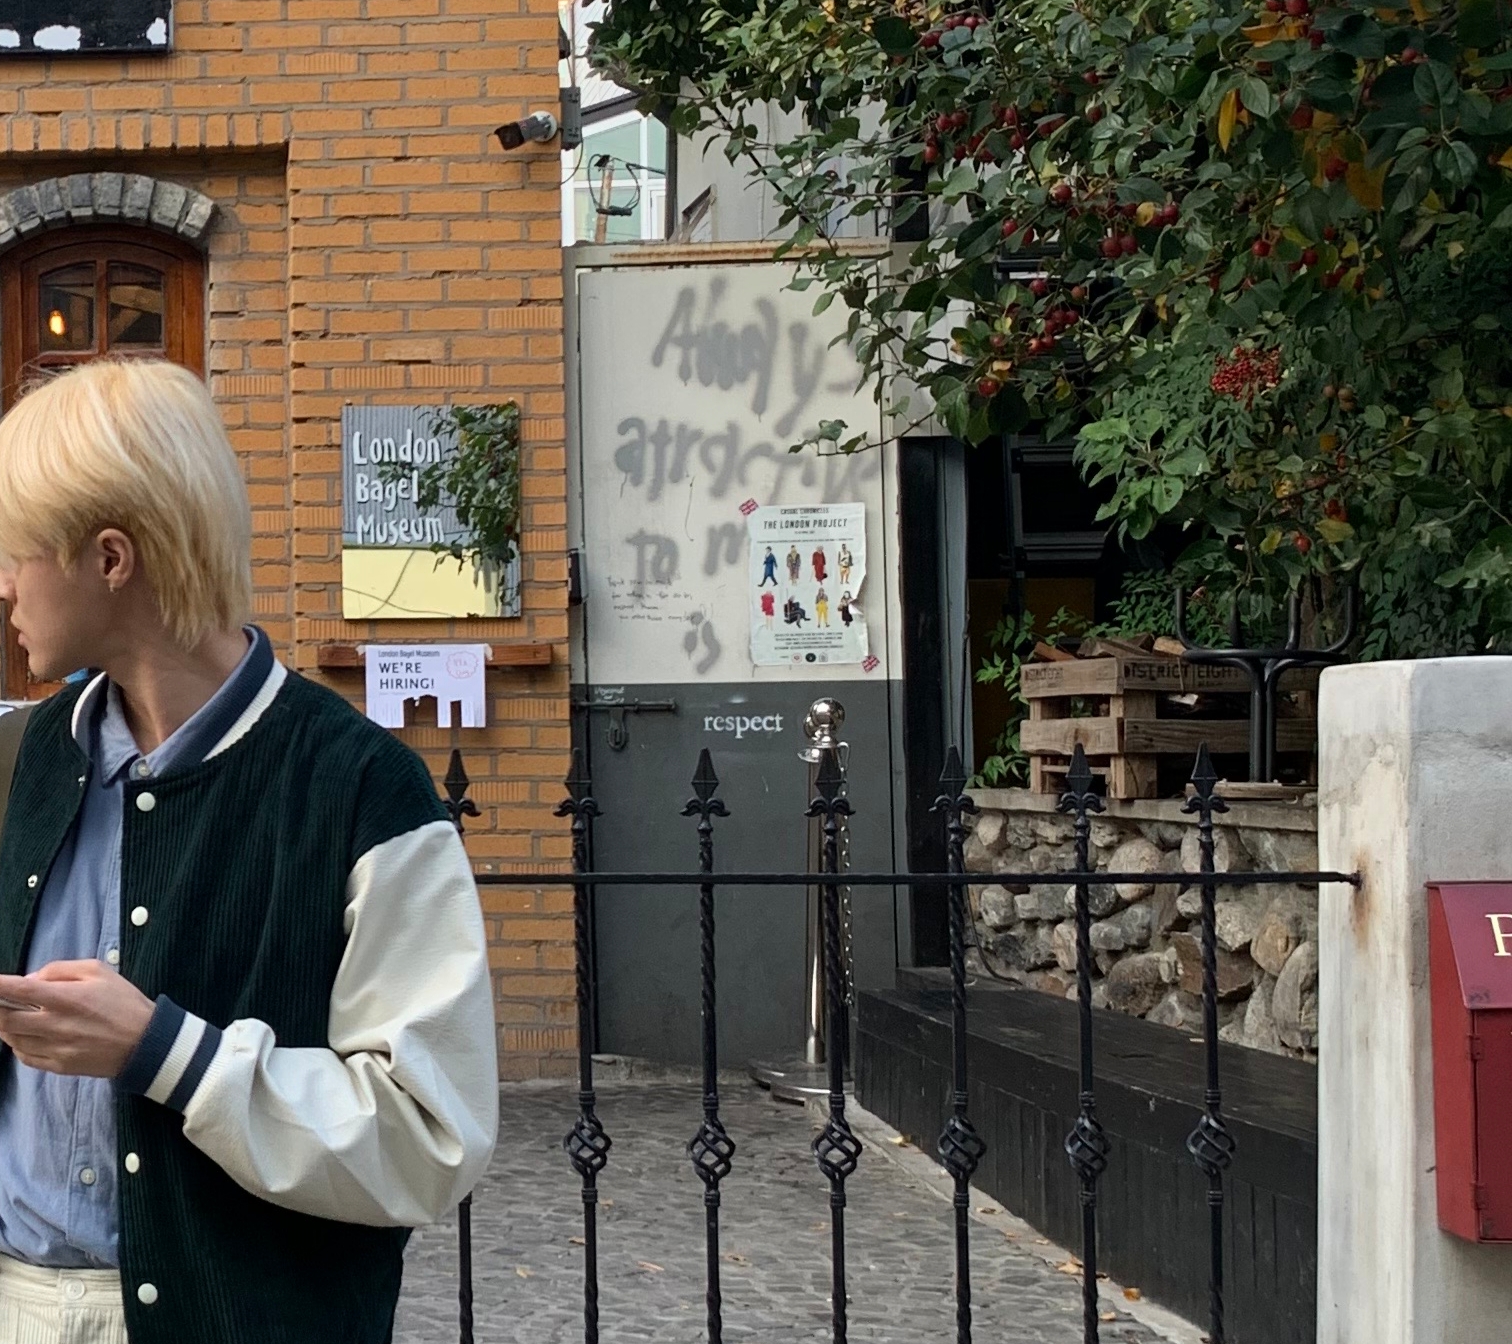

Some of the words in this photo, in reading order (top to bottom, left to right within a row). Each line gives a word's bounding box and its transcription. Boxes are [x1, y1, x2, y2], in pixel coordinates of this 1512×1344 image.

[353, 429, 441, 465] London
[355, 470, 419, 511] Bagel
[356, 514, 445, 546] Museum
[764, 520, 777, 529] THE
[780, 519, 809, 529] LONDON
[813, 518, 848, 528] PROJECT
[379, 678, 435, 690] HIRING!
[703, 713, 784, 739] respect
